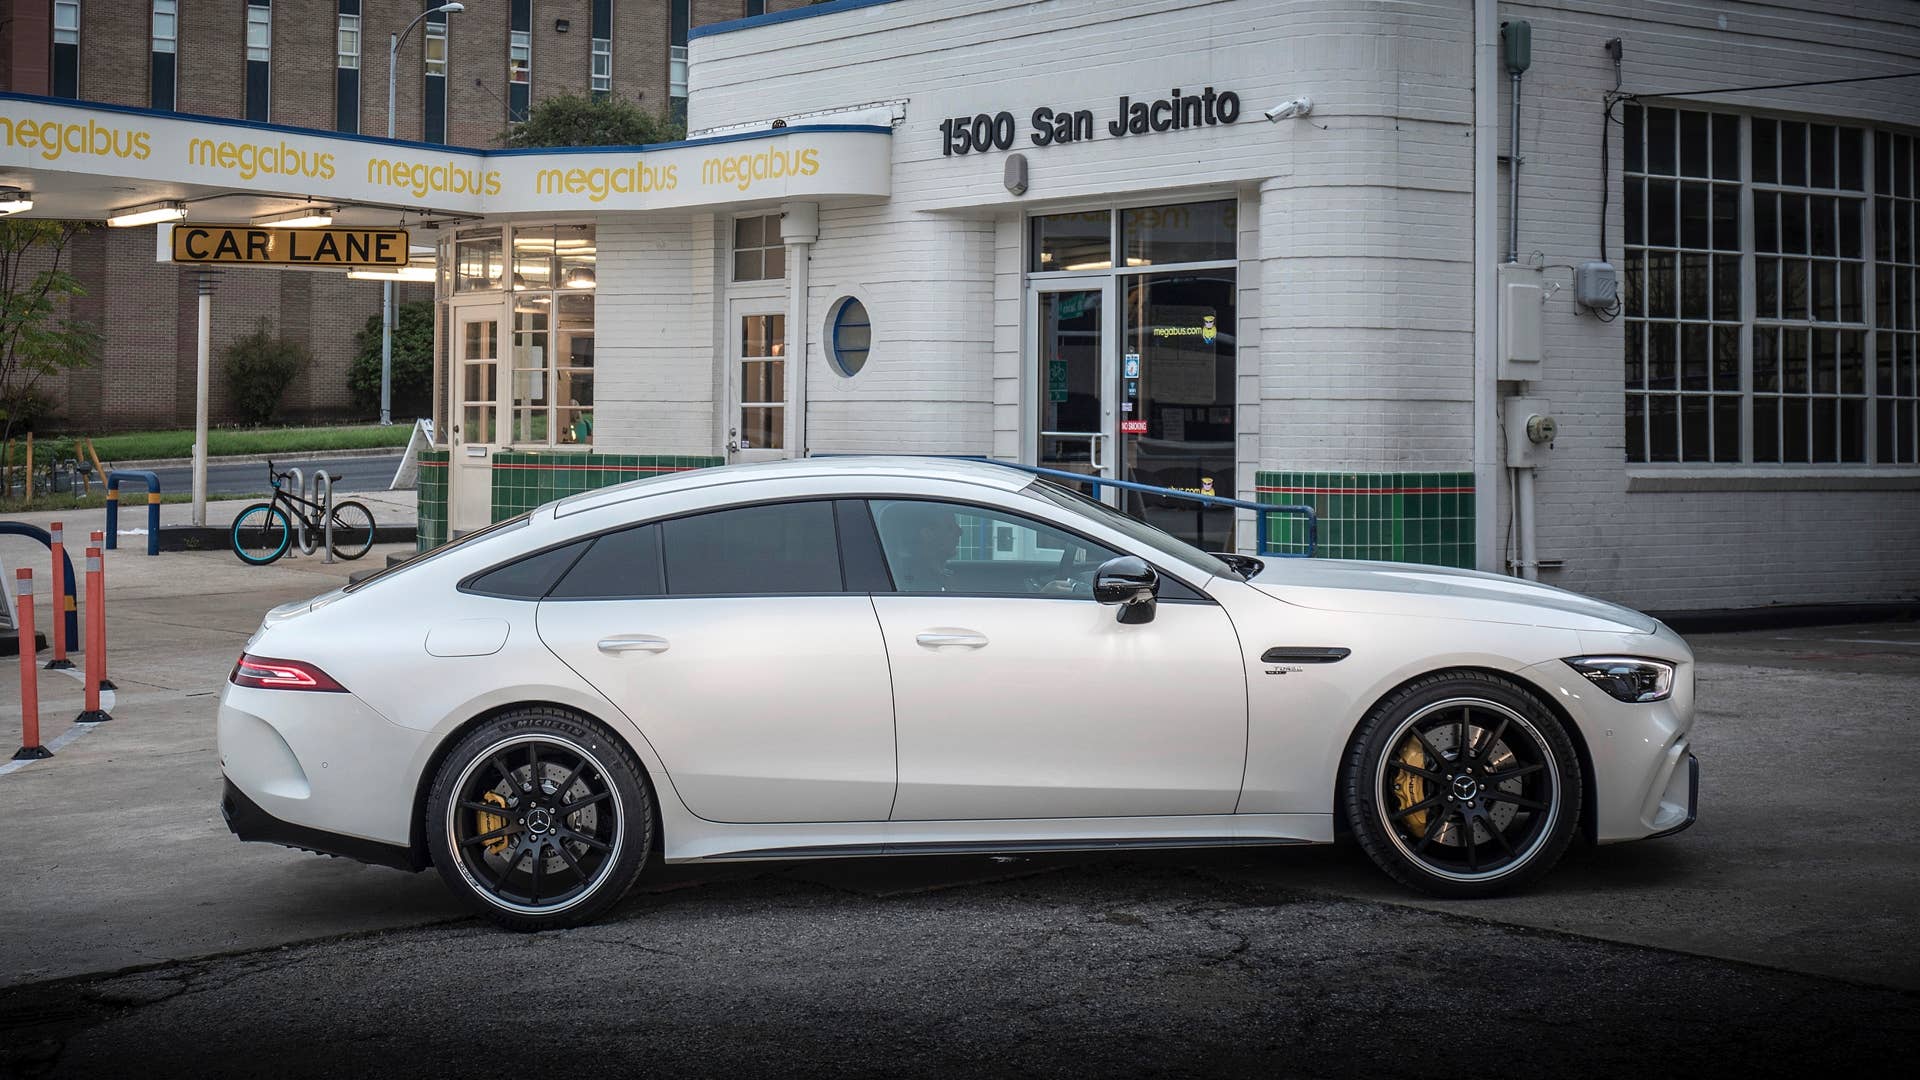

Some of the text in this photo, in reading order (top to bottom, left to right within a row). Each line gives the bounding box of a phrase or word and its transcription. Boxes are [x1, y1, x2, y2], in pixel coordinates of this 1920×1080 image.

[939, 87, 1241, 156] 1500 San Jacinto
[188, 139, 336, 180] megabus
[367, 158, 502, 198] megabus
[702, 146, 820, 191] megabus
[537, 160, 678, 202] megabus
[185, 229, 397, 263] CAR LANE
[1153, 327, 1202, 338] megabus.com
[1121, 422, 1147, 430] NO SMOKING
[516, 719, 584, 736] MICHELIN
